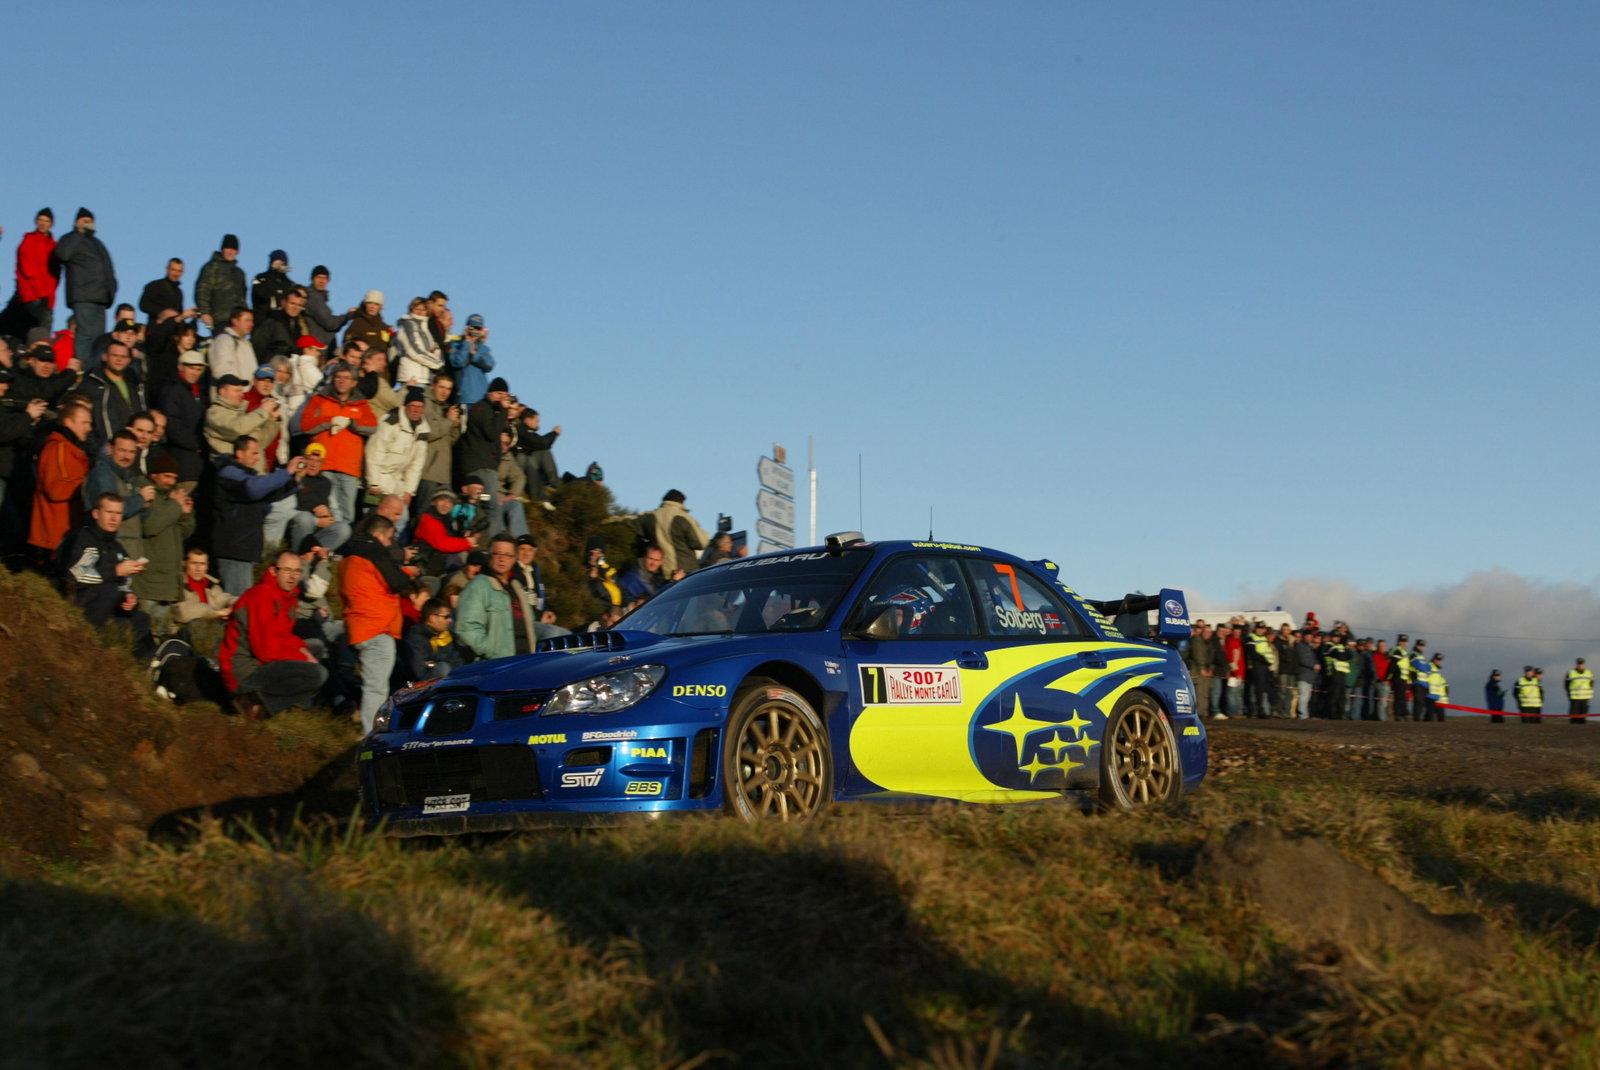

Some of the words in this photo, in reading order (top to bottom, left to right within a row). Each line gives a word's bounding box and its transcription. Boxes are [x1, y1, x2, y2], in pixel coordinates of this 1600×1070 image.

[729, 552, 829, 570] SUBARU
[993, 564, 1025, 611] 7
[995, 605, 1046, 635] Solberg
[903, 671, 943, 685] 2007
[673, 685, 727, 697] DENSO
[868, 668, 879, 703] 7
[890, 675, 913, 700] RALLYE
[528, 734, 567, 745] MOTUL
[582, 730, 637, 740] BFGoodrich
[631, 748, 667, 758] PIAA
[627, 782, 659, 793] BBS
